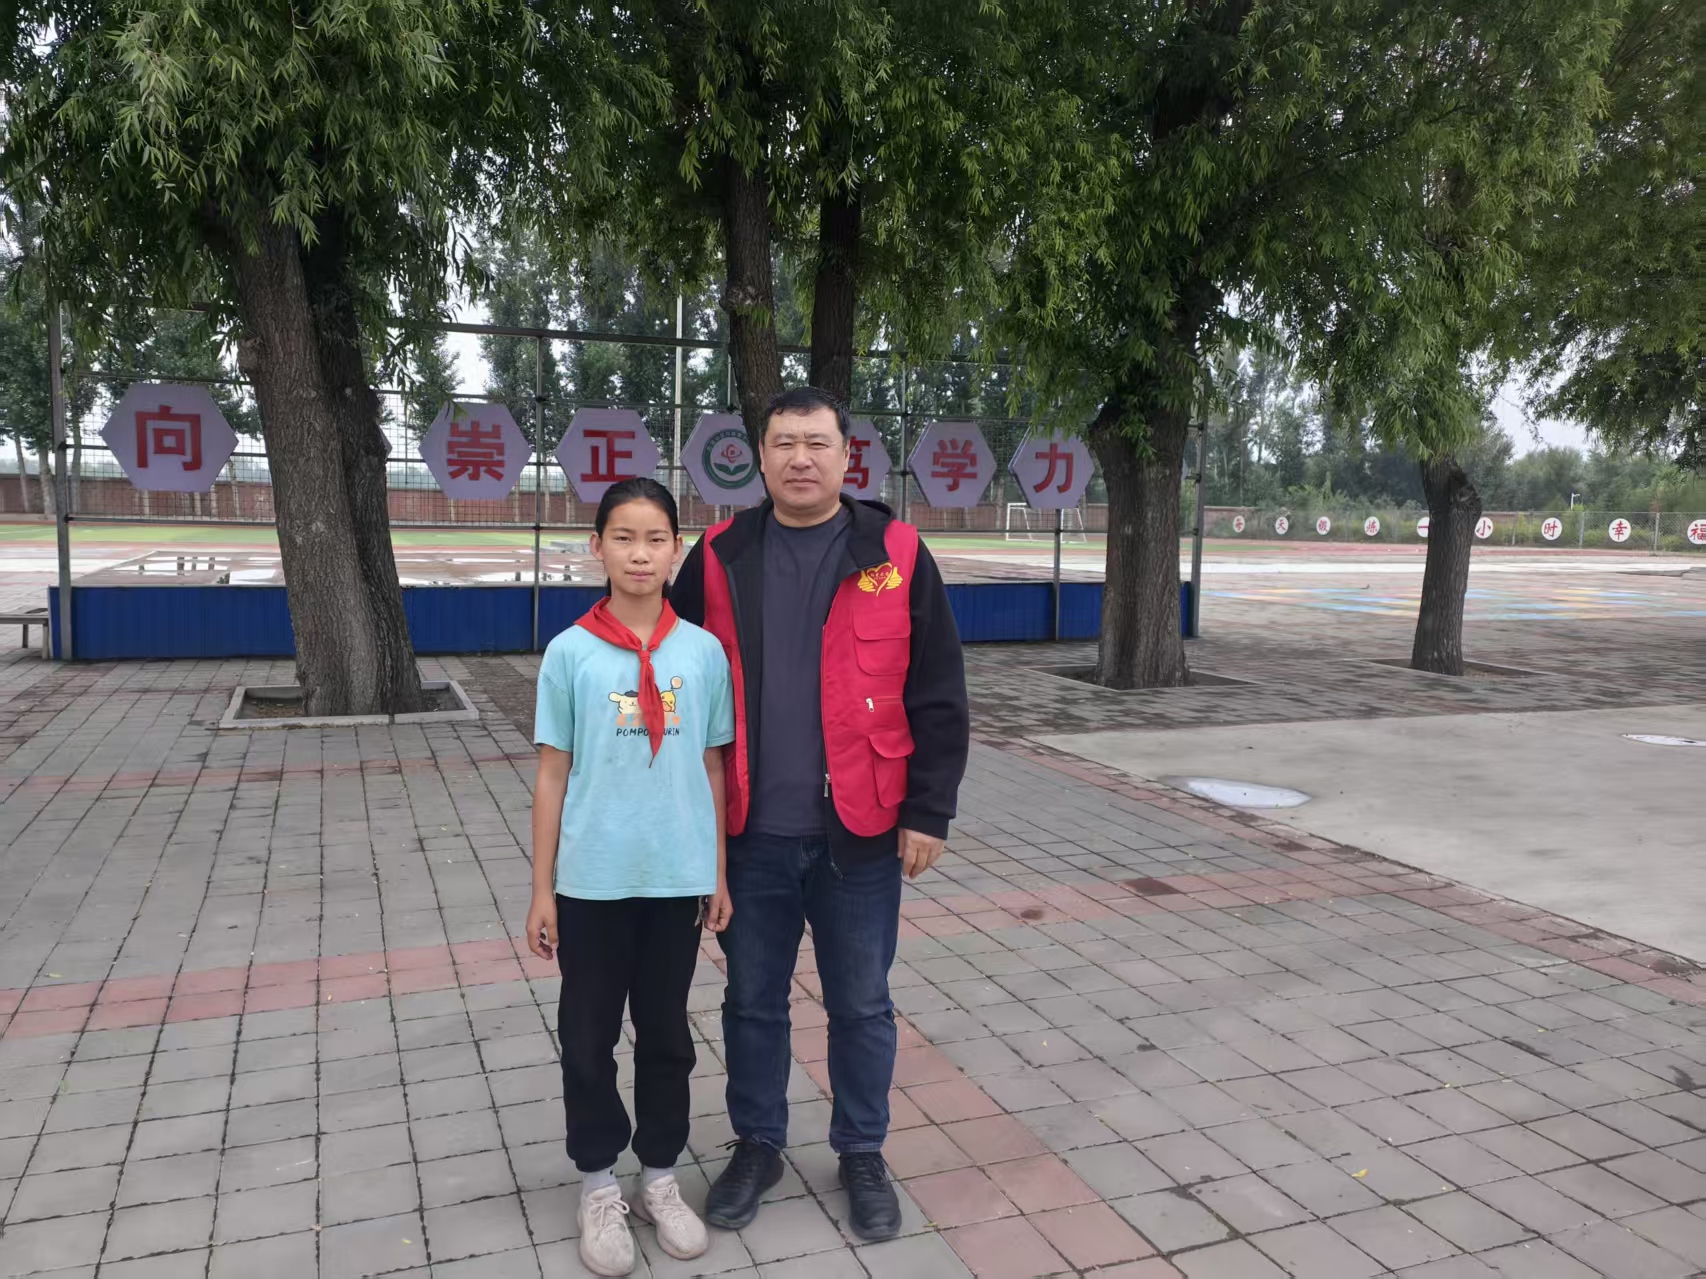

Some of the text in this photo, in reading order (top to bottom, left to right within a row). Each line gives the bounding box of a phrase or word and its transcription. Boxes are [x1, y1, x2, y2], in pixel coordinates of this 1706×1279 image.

[135, 405, 202, 471] 向
[447, 421, 505, 479] 崇
[580, 429, 638, 482] 正
[931, 439, 977, 491] 学
[1033, 444, 1074, 492] 力
[1476, 520, 1491, 536] 小
[1543, 520, 1558, 537] 时
[1612, 520, 1628, 539] 幸
[616, 728, 680, 736] POMPOURIN
